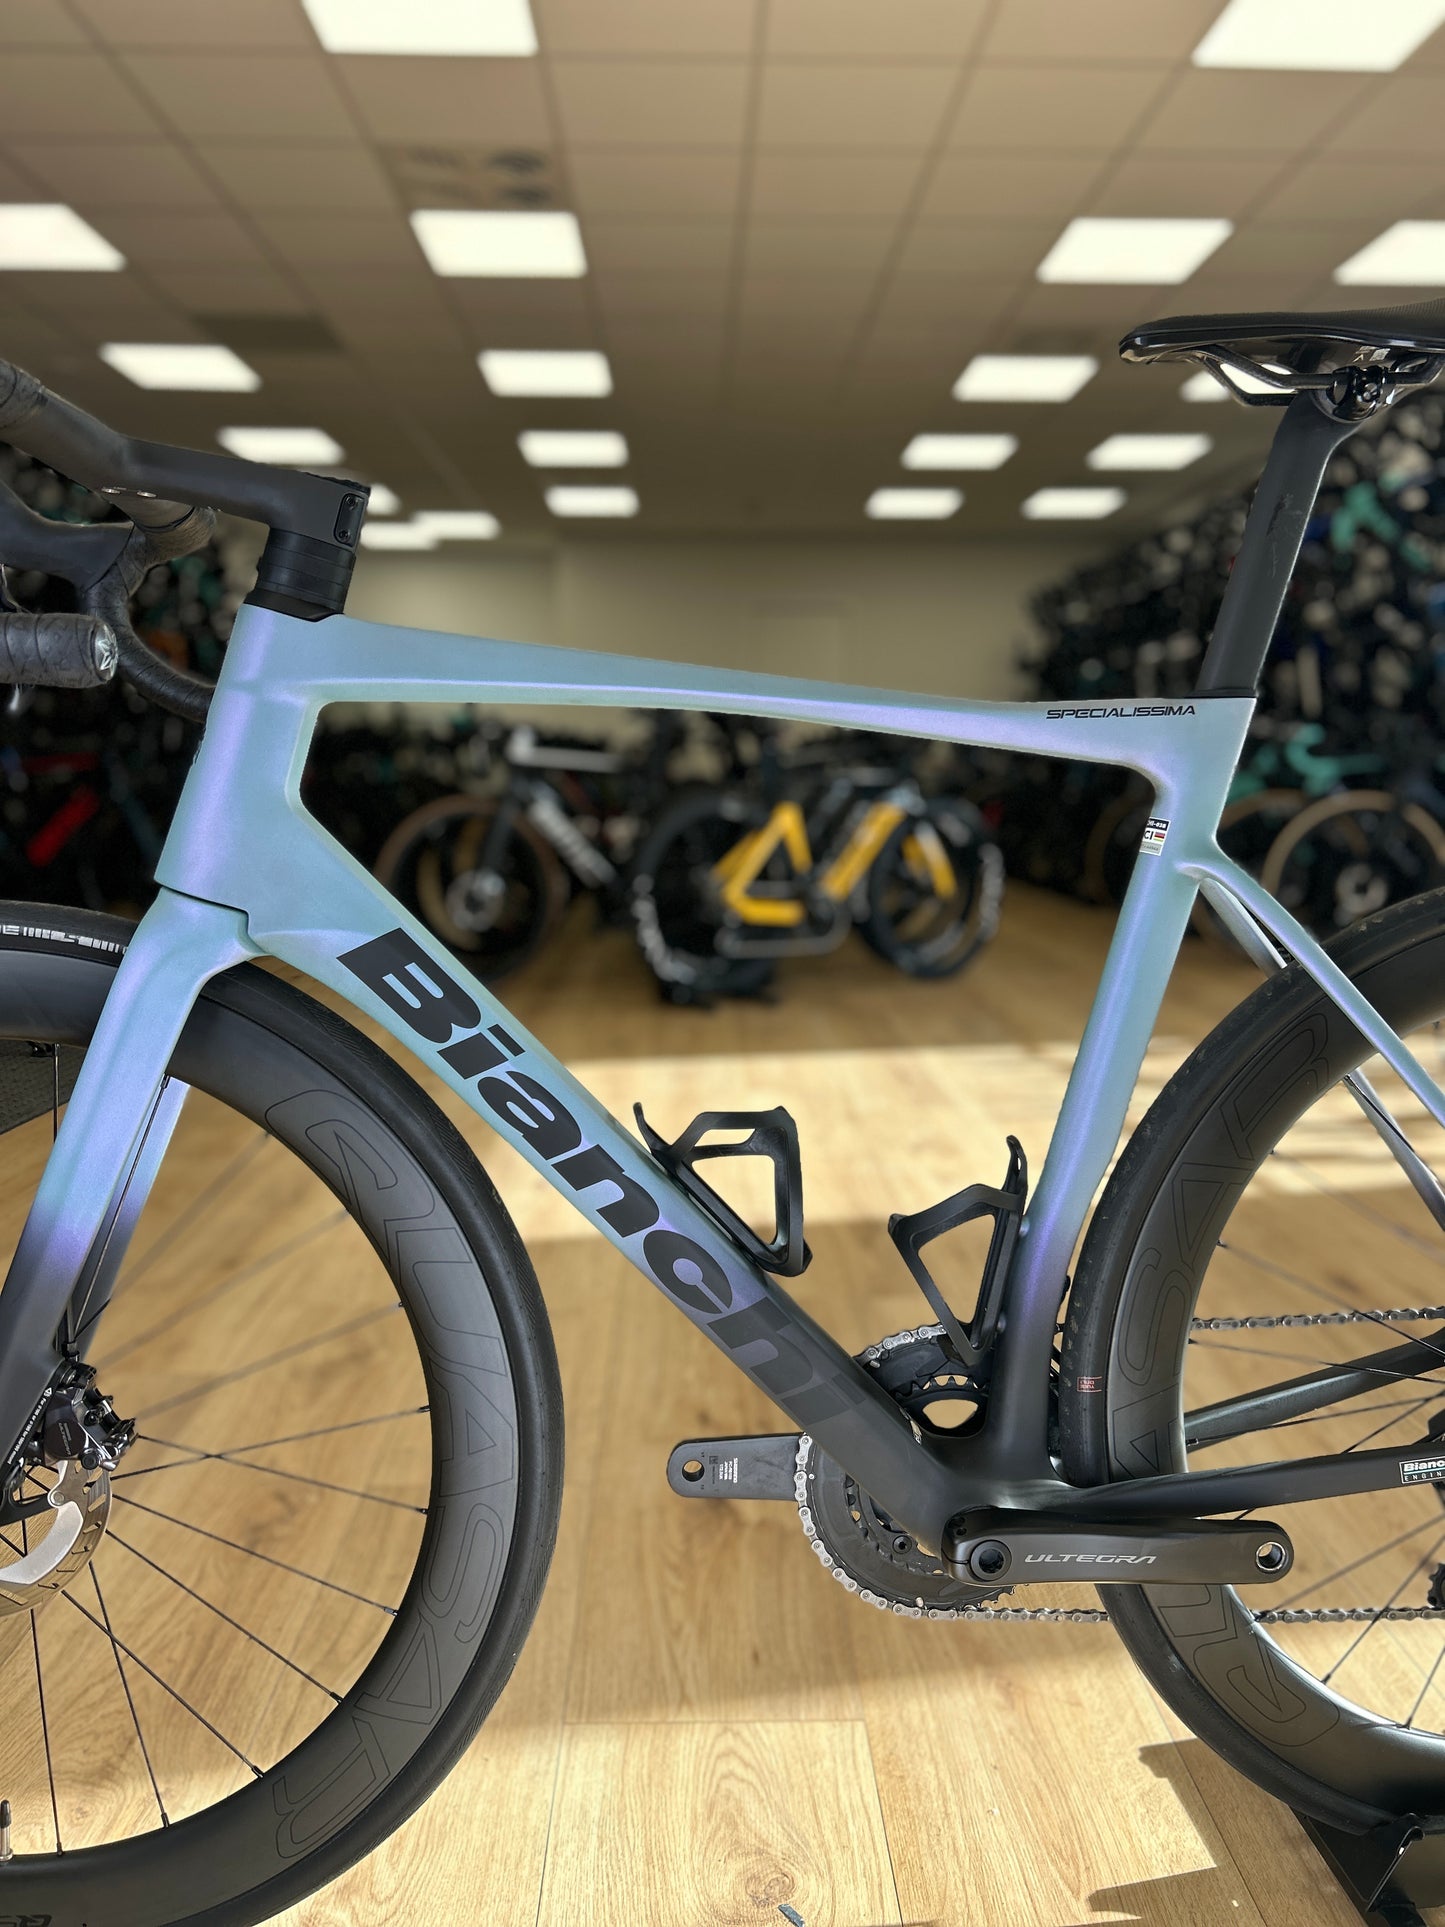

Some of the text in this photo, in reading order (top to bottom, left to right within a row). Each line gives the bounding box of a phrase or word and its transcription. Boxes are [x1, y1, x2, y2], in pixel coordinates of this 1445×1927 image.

[1046, 704, 1196, 720] SPECIALISSIMA
[336, 926, 867, 1427] Bianchi
[264, 1089, 518, 1860] QUASAR
[1024, 1553, 1157, 1565] ULTEGRA
